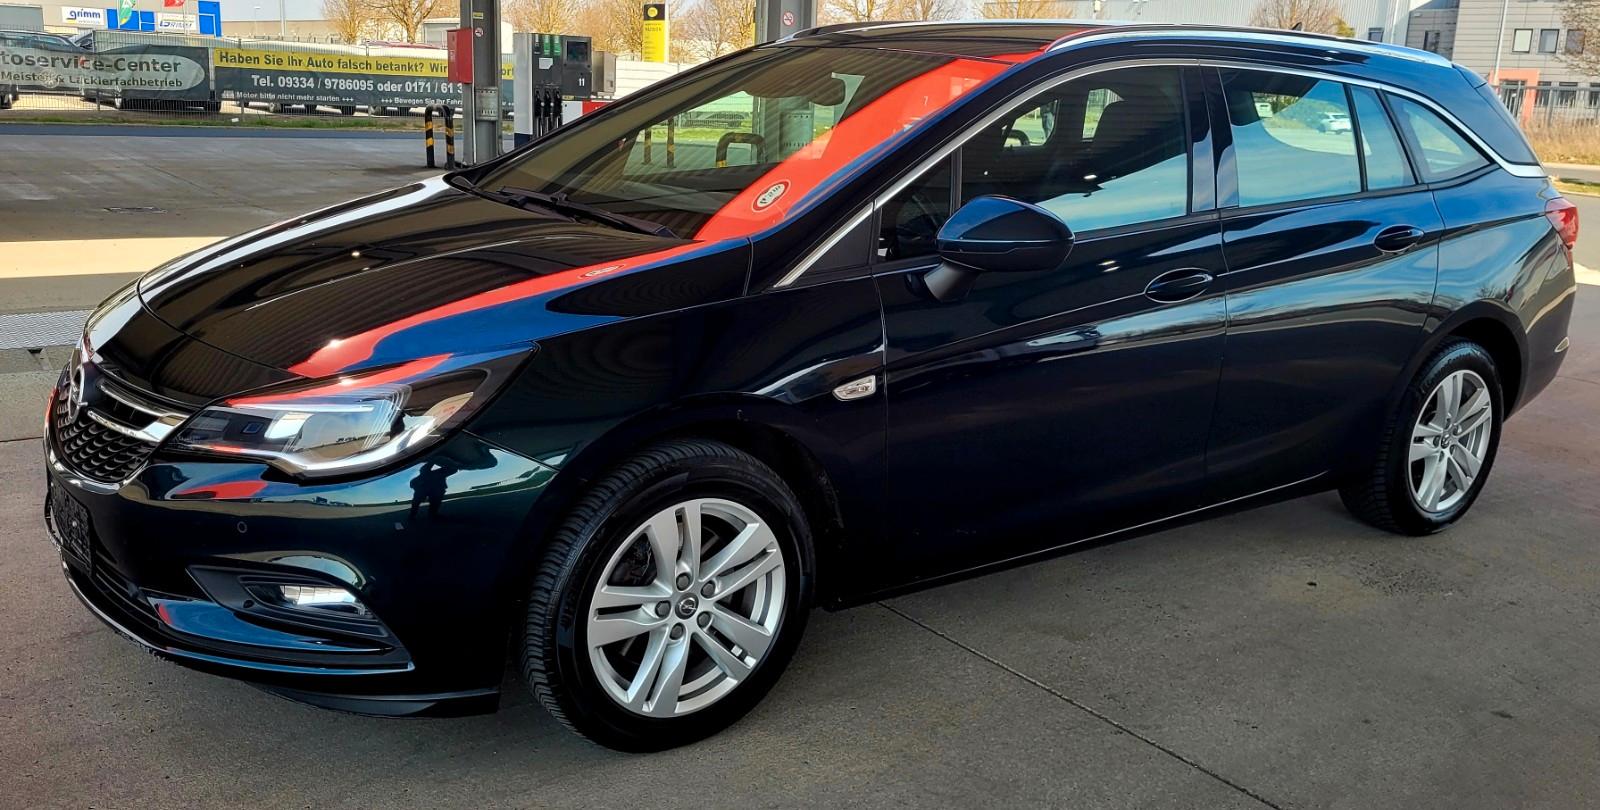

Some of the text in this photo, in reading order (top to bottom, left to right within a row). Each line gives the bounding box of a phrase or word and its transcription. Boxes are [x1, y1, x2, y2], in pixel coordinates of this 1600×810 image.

[67, 9, 101, 20] grimm
[220, 51, 448, 73] Haben Sie Ihr Auto falsch betankt? Wir
[251, 74, 274, 87] Tel.
[278, 76, 315, 89] 09334
[324, 79, 374, 91] 9786095
[377, 81, 402, 92] oder
[405, 81, 432, 93] 0171
[440, 82, 454, 94] 61
[236, 91, 258, 99] Motor
